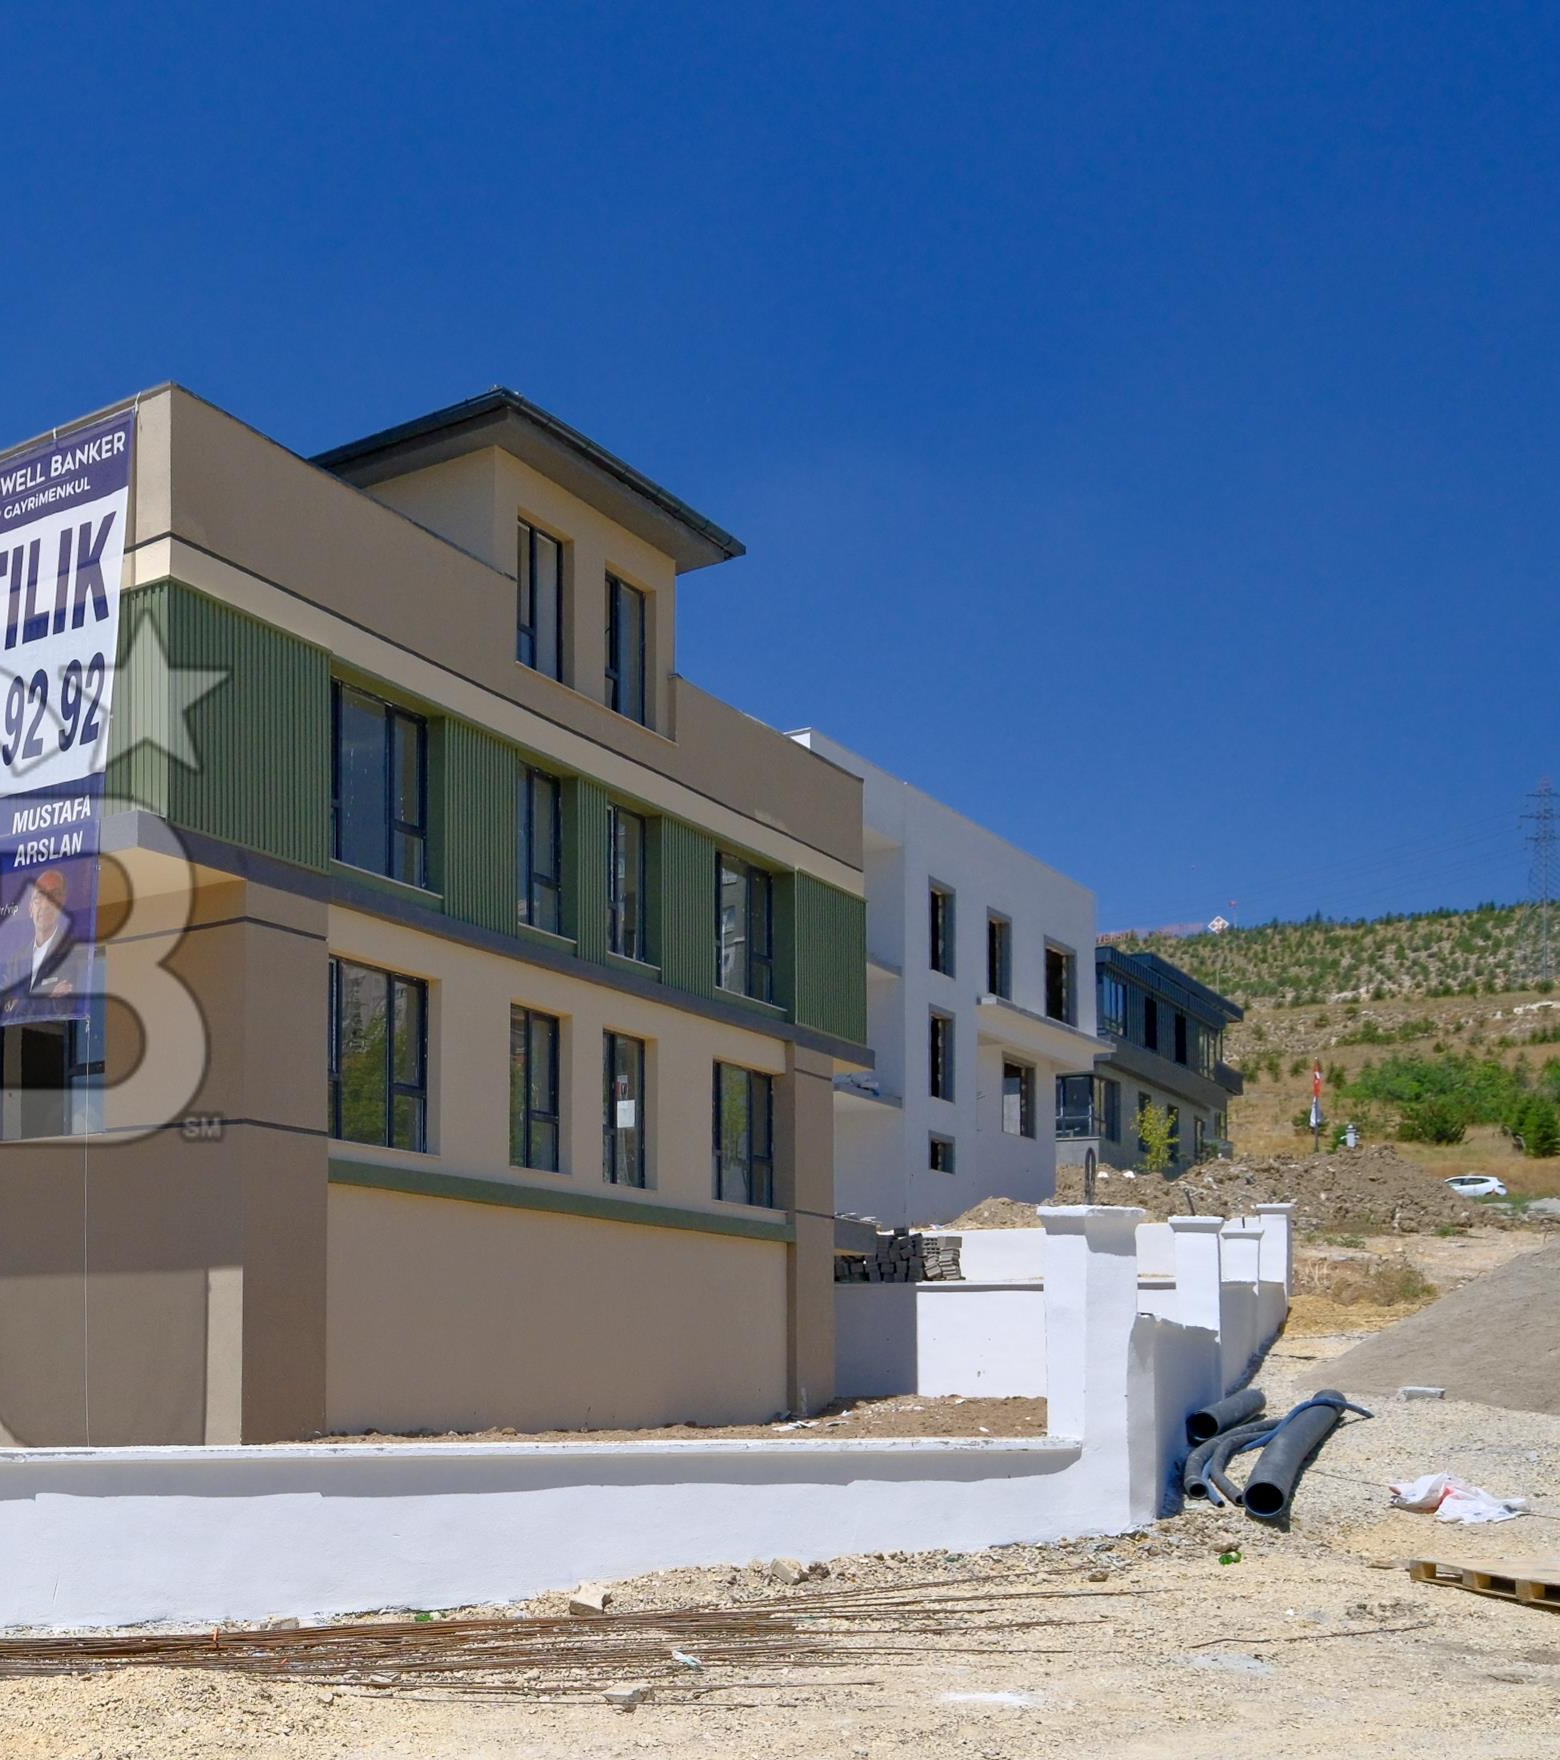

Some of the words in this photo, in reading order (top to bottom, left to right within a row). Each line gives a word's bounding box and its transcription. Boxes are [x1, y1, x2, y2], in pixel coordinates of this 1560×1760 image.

[50, 431, 126, 478] BANKER
[3, 477, 91, 520] GAYRİMENKUL
[2, 668, 49, 766] 92
[58, 652, 105, 752] 92
[12, 795, 91, 835] MUSTAFA
[14, 831, 84, 867] ARSLAN
